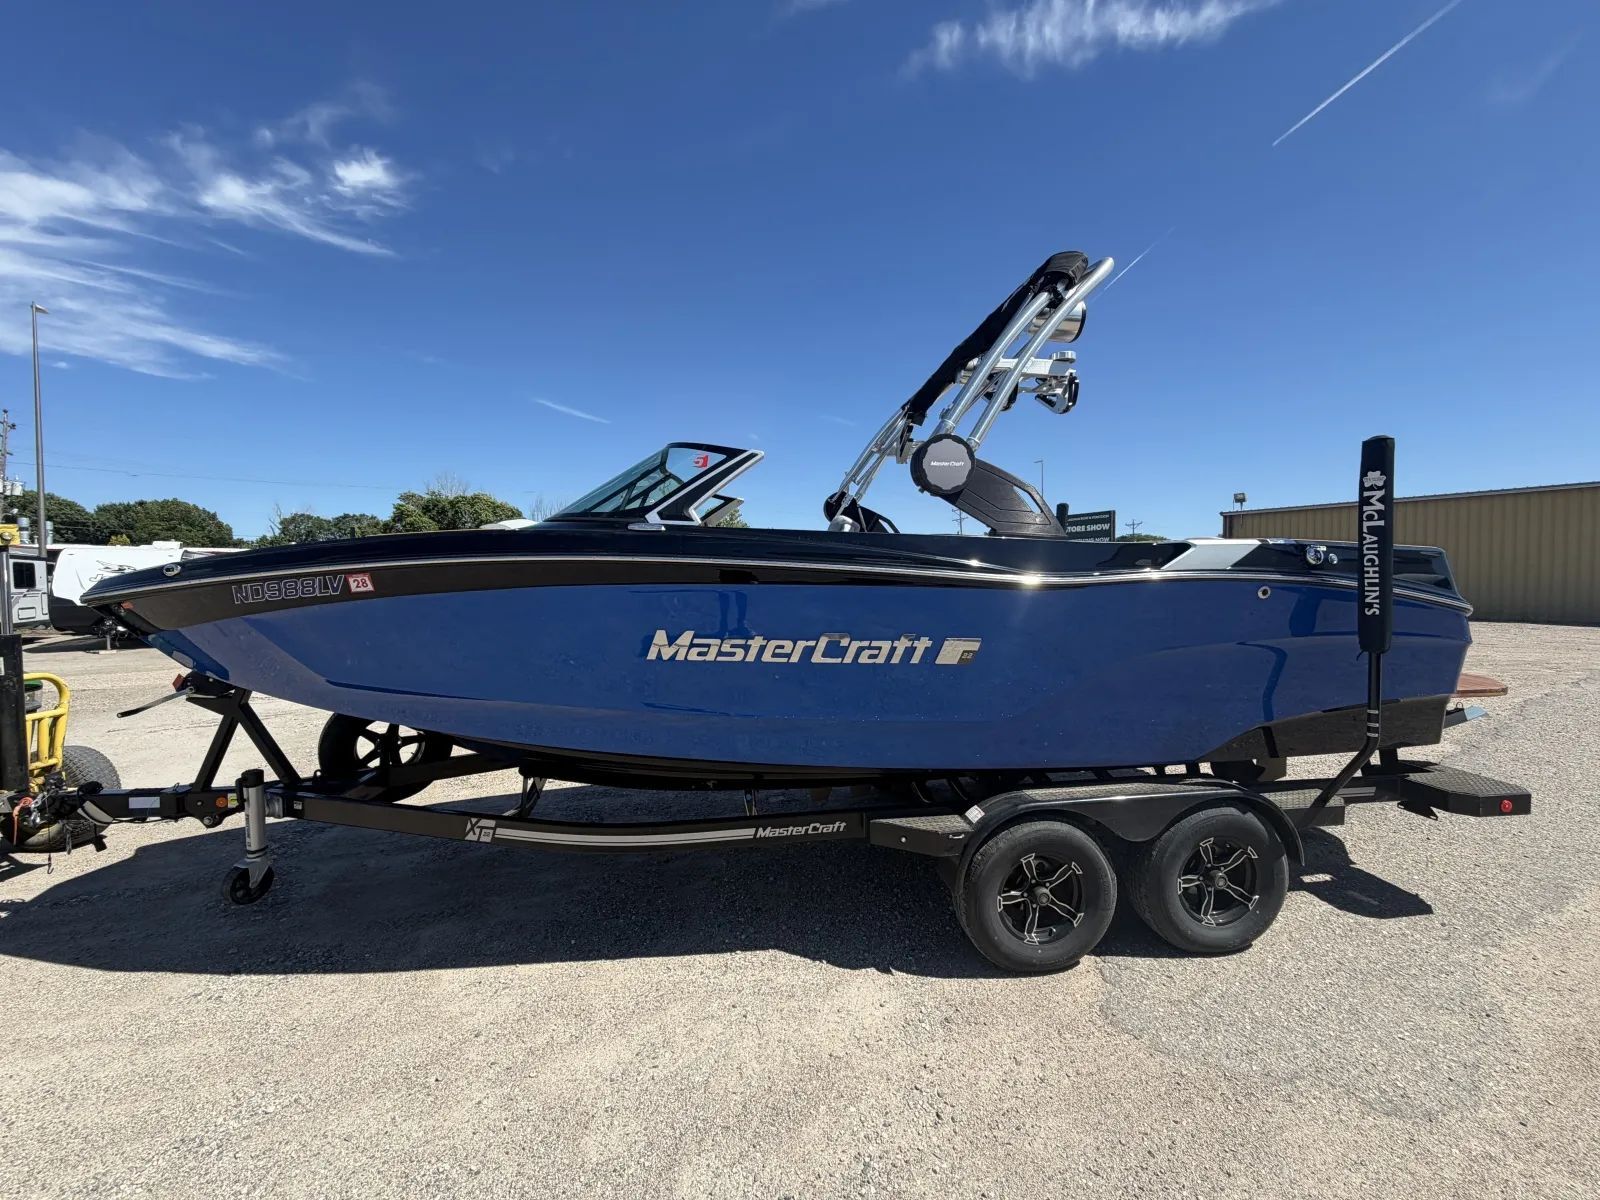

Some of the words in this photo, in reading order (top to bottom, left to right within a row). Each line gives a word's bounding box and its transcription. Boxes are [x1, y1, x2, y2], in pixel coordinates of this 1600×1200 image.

[1066, 525, 1086, 533] TORE
[1086, 523, 1110, 532] SHOW
[232, 575, 345, 604] ND988LV
[352, 578, 369, 589] 28
[646, 629, 933, 664] MasterCraft
[756, 821, 847, 838] MasterCraft
